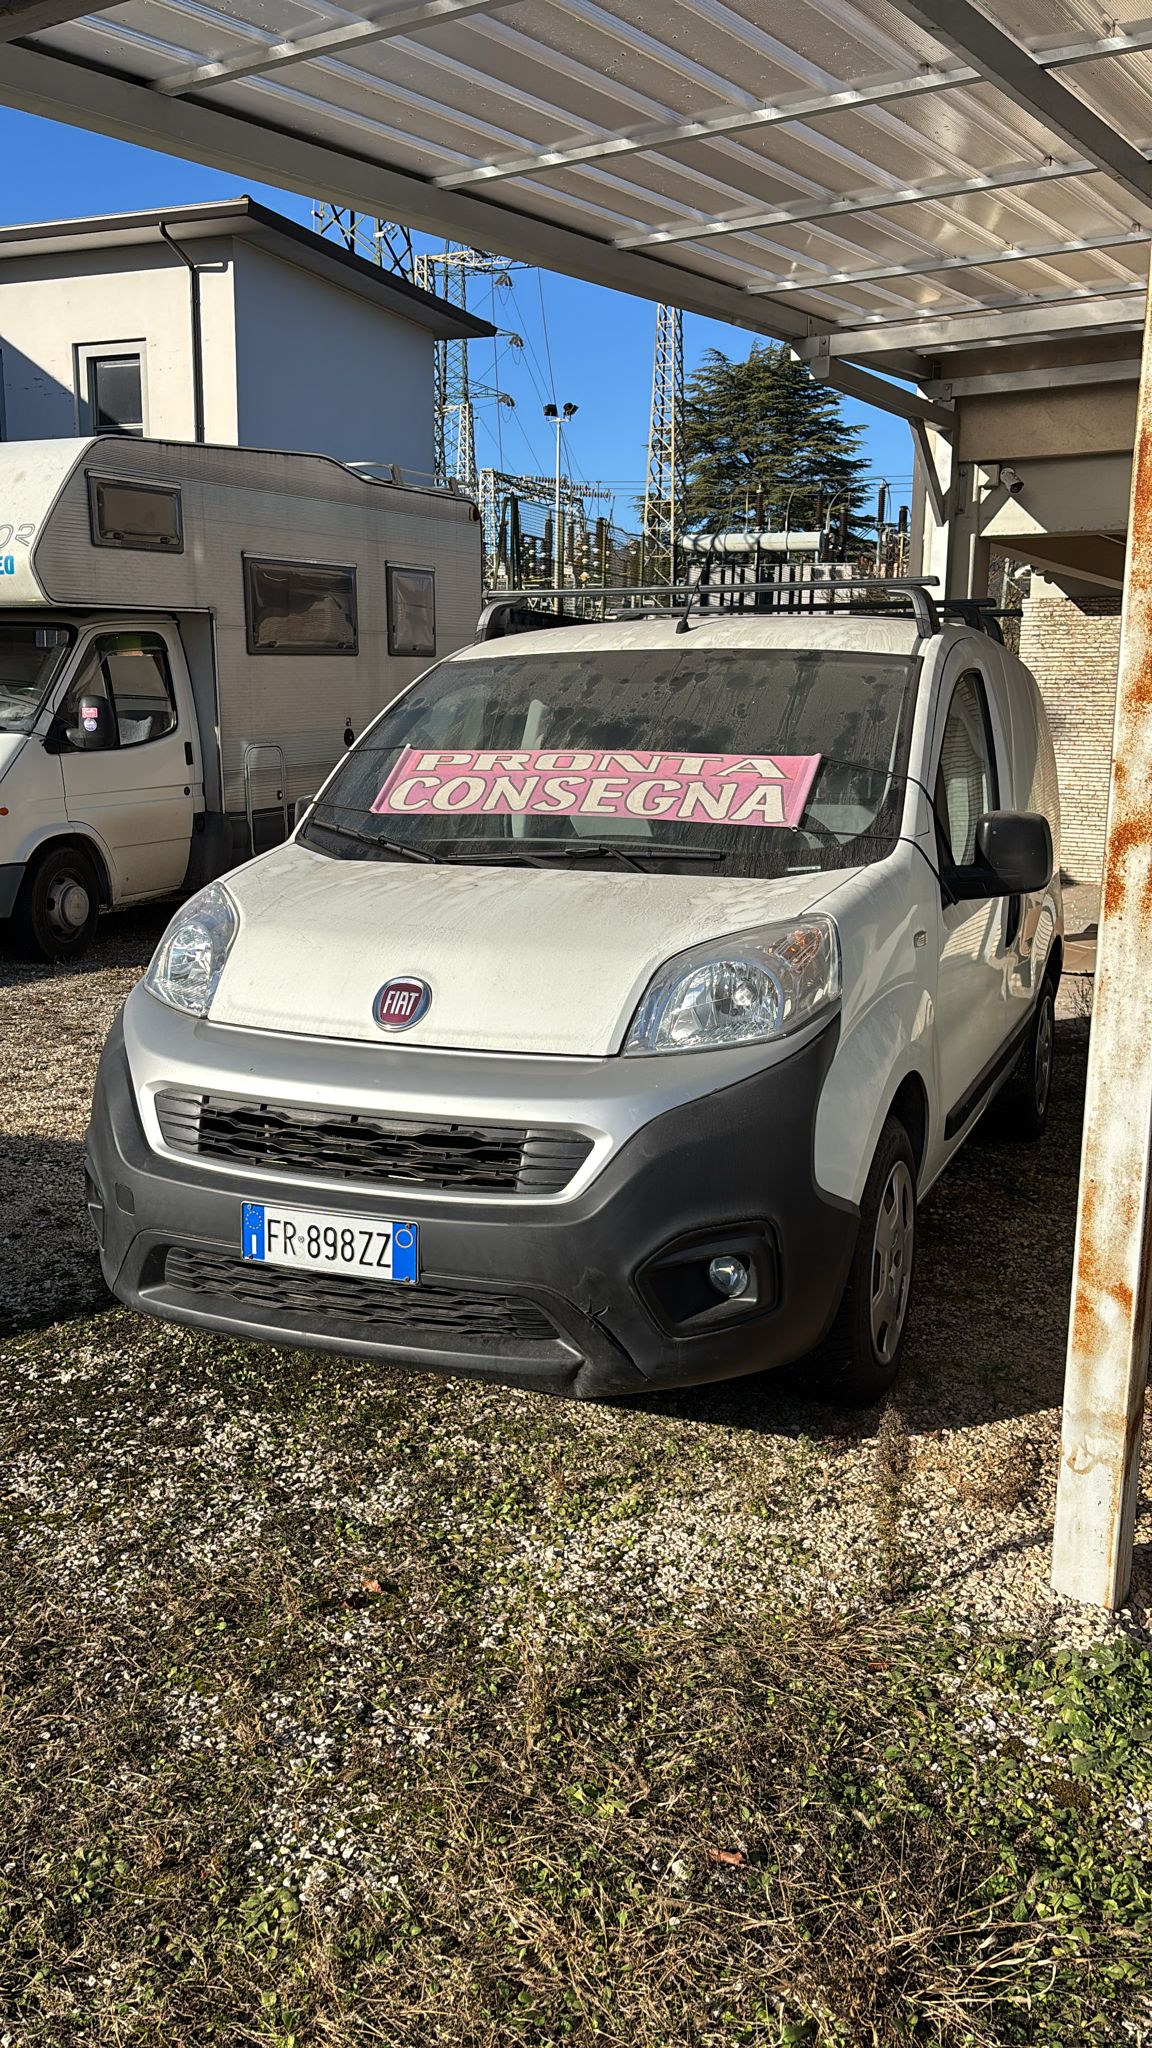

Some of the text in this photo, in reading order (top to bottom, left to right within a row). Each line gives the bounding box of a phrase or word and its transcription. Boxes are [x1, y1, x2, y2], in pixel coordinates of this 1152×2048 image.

[415, 752, 791, 779] PRONTA
[387, 774, 788, 822] CONSEGNA
[382, 990, 420, 1016] FIAT
